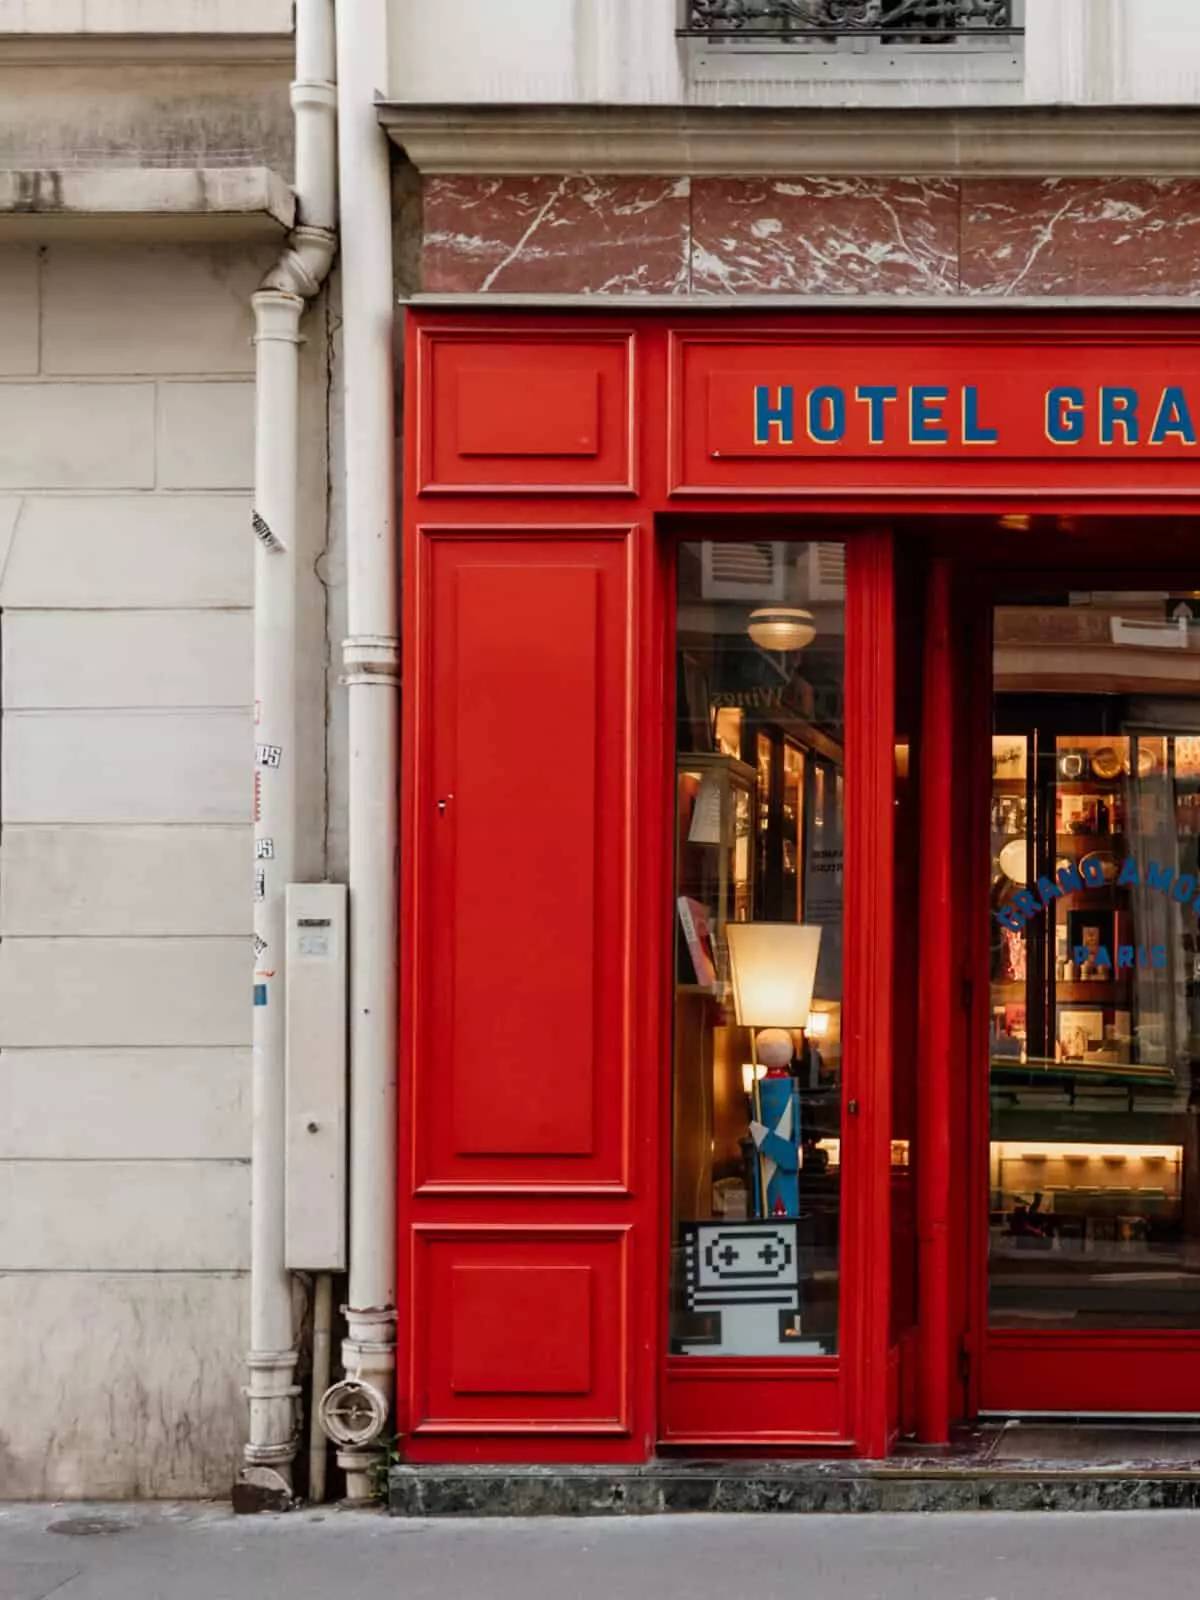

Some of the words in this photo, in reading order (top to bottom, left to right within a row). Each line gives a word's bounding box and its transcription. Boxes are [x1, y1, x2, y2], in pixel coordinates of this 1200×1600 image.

[753, 385, 999, 445] HOTEL
[996, 858, 1105, 932] GRAND
[1073, 944, 1167, 969] PARIS
